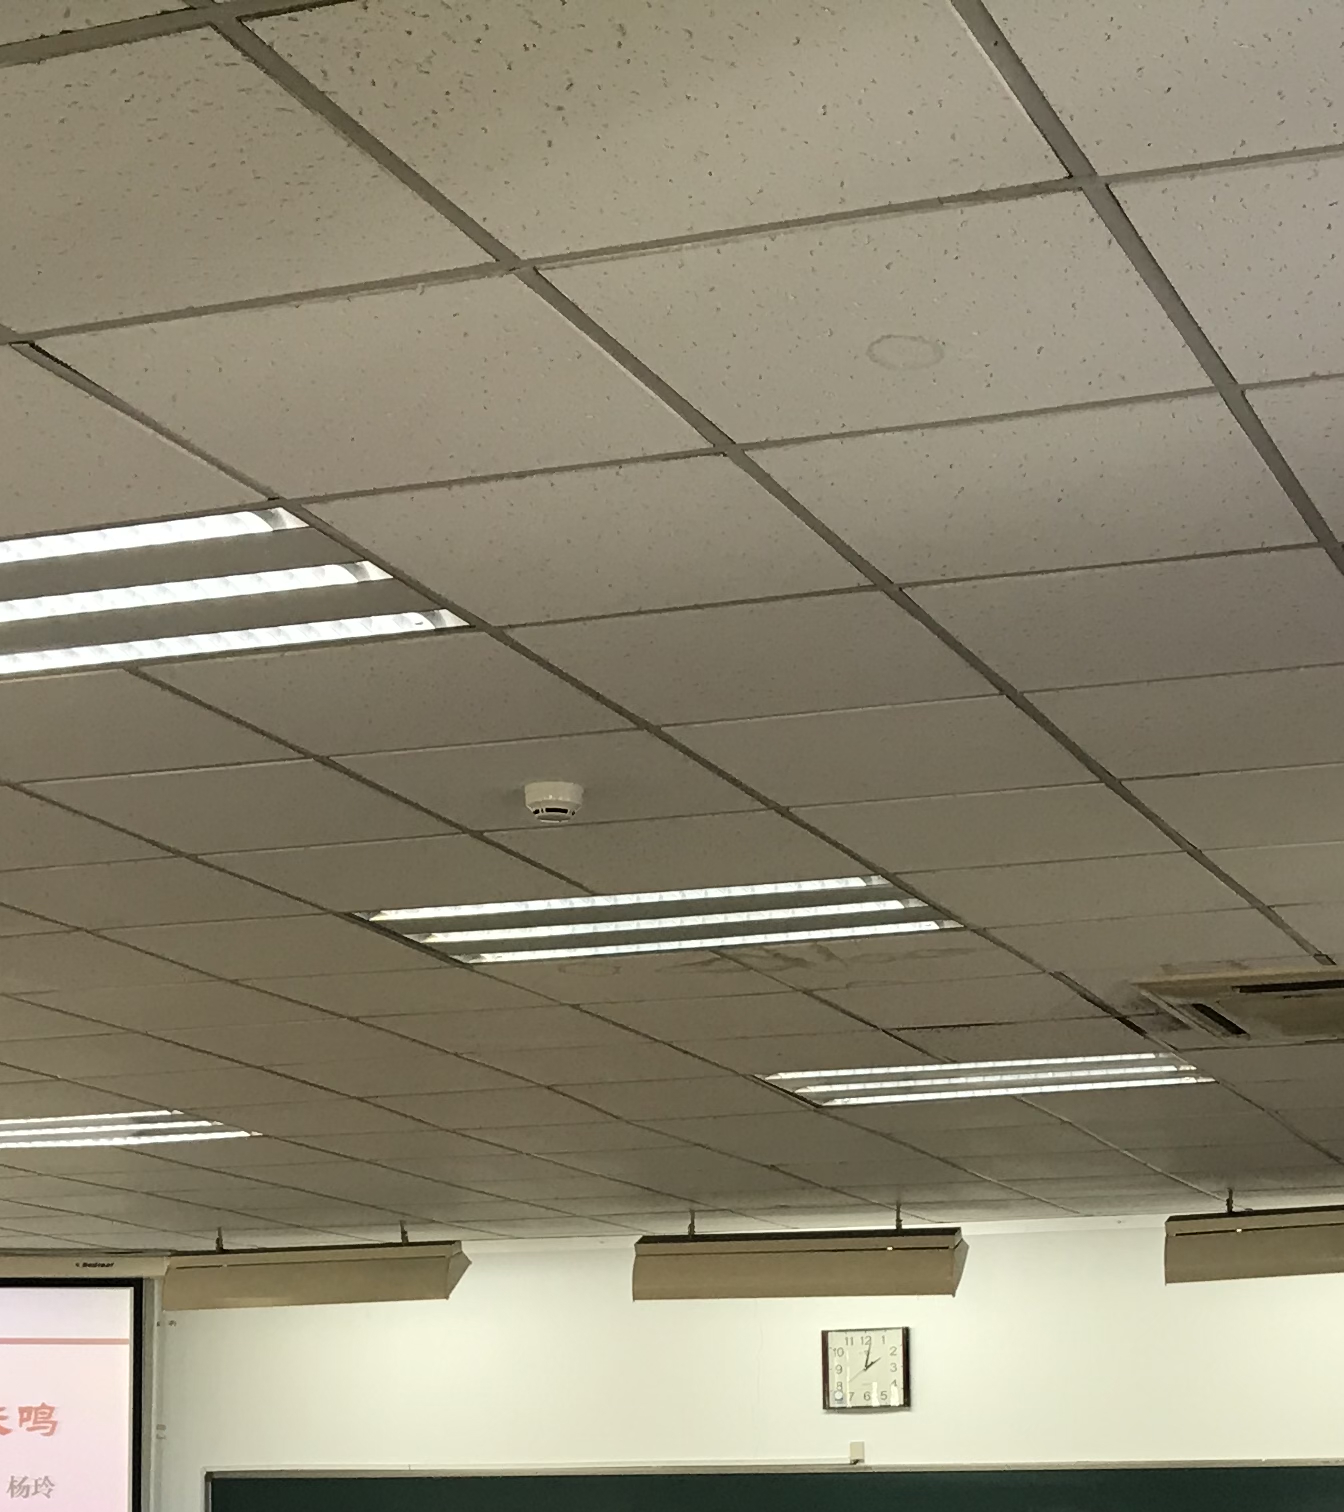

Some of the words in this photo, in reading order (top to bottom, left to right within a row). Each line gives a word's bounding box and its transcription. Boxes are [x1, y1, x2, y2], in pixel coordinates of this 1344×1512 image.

[845, 1336, 854, 1346] 11
[860, 1335, 872, 1346] 12
[881, 1335, 885, 1344] 1
[833, 1347, 844, 1357] 10
[889, 1346, 898, 1356] 2
[835, 1364, 843, 1374] 9
[890, 1362, 898, 1373] 3
[836, 1381, 843, 1391] 8
[849, 1391, 855, 1401] 7
[863, 1391, 871, 1401] 6
[880, 1390, 888, 1401] 5
[5, 1475, 56, 1500] 杨玲
